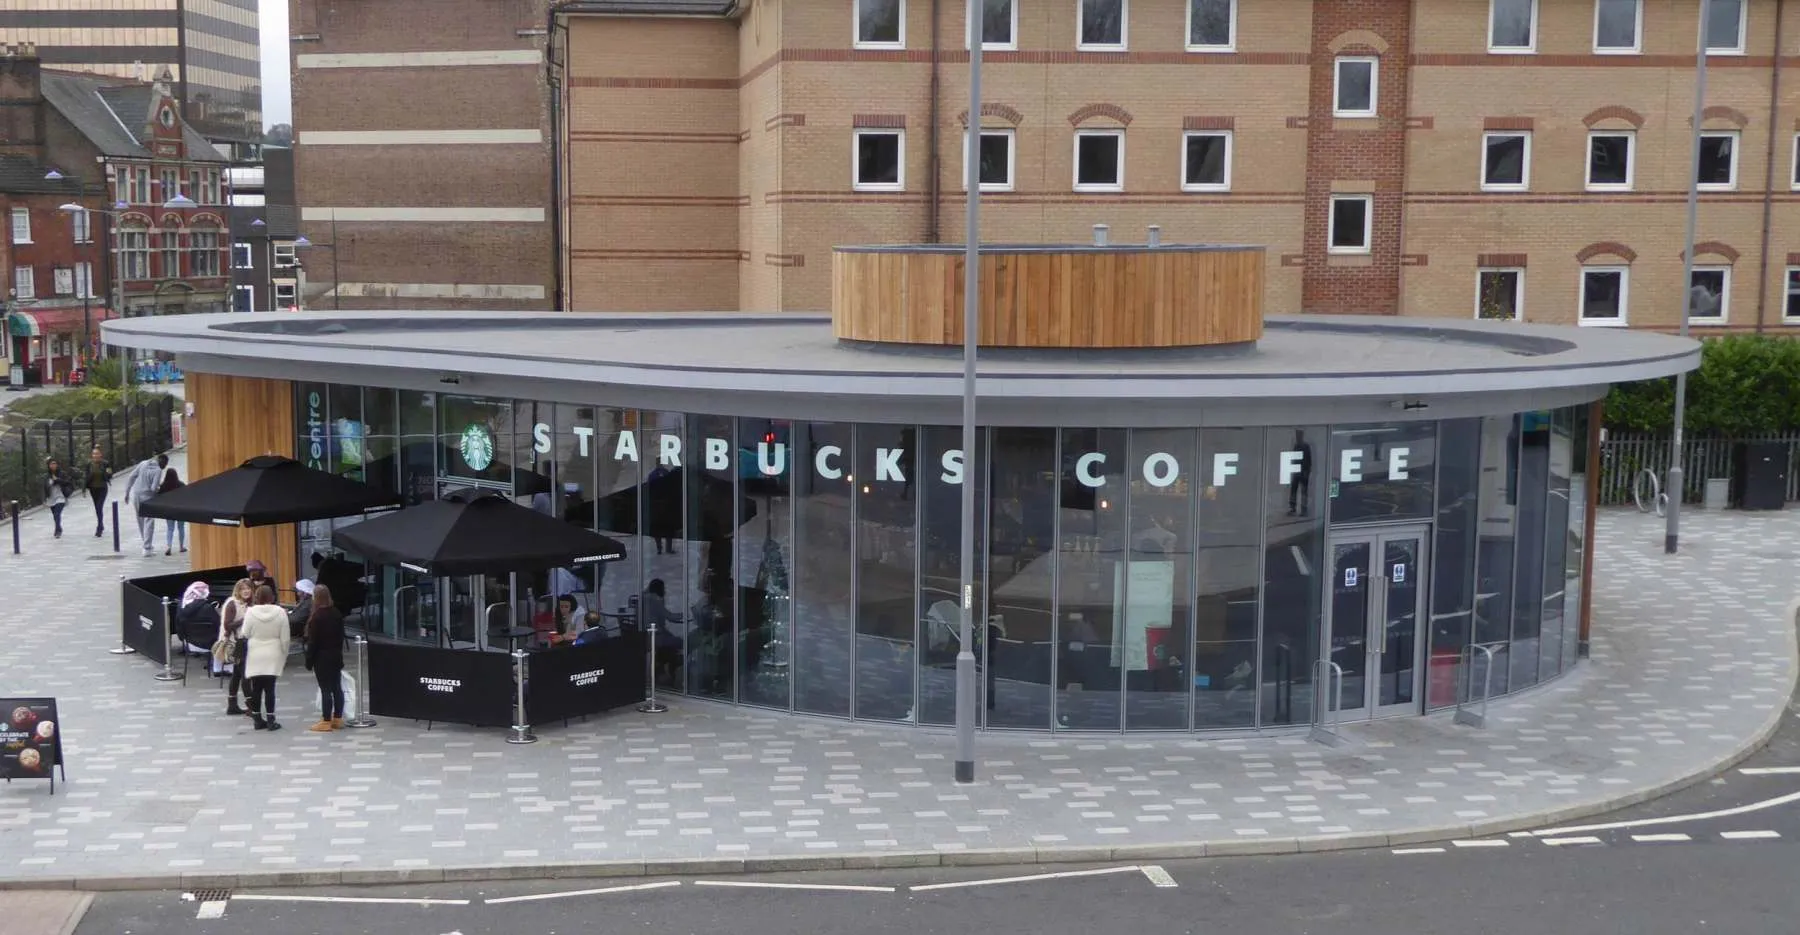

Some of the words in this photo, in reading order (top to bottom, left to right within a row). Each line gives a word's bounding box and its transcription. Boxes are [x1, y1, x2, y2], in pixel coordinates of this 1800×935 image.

[533, 422, 963, 484] STARBUCKS
[1075, 447, 1410, 487] COFFEE
[570, 669, 605, 681] STARBUCKS
[420, 677, 461, 687] STARBUCKS
[576, 677, 598, 686] COFFEE
[427, 684, 454, 692] COFFEE
